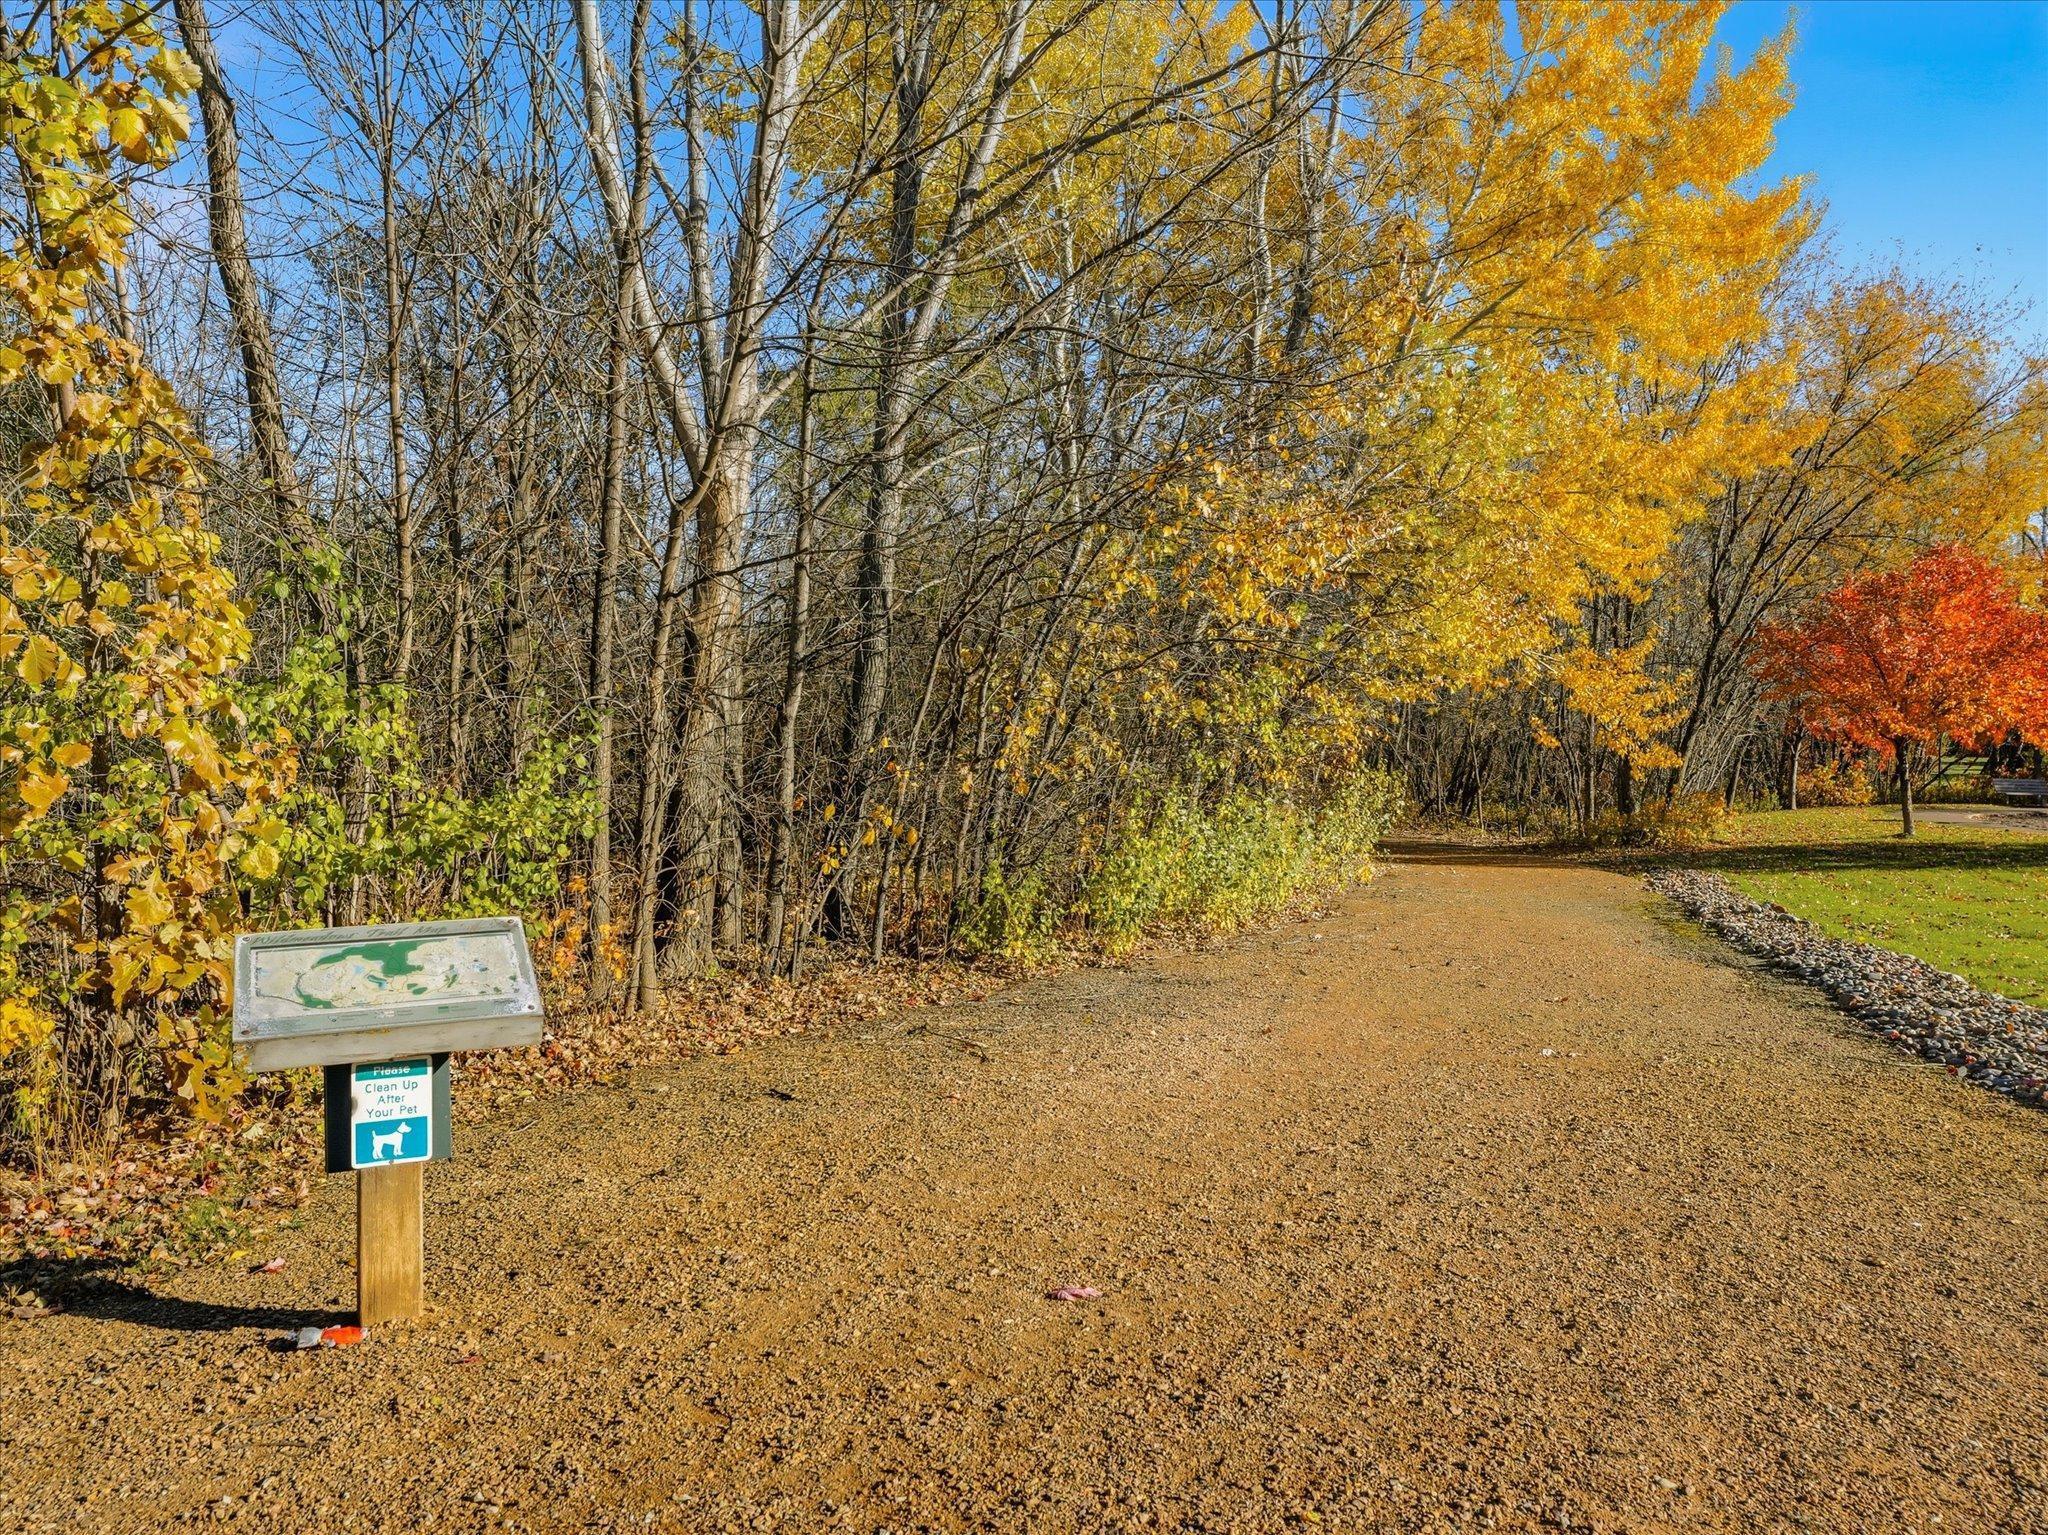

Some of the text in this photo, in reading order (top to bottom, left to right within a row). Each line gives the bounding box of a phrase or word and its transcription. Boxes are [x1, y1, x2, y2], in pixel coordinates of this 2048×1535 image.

[373, 1066, 410, 1076] Please
[365, 1080, 418, 1093] Clean Up
[377, 1094, 406, 1105] After
[366, 1105, 418, 1118] Your Pet
